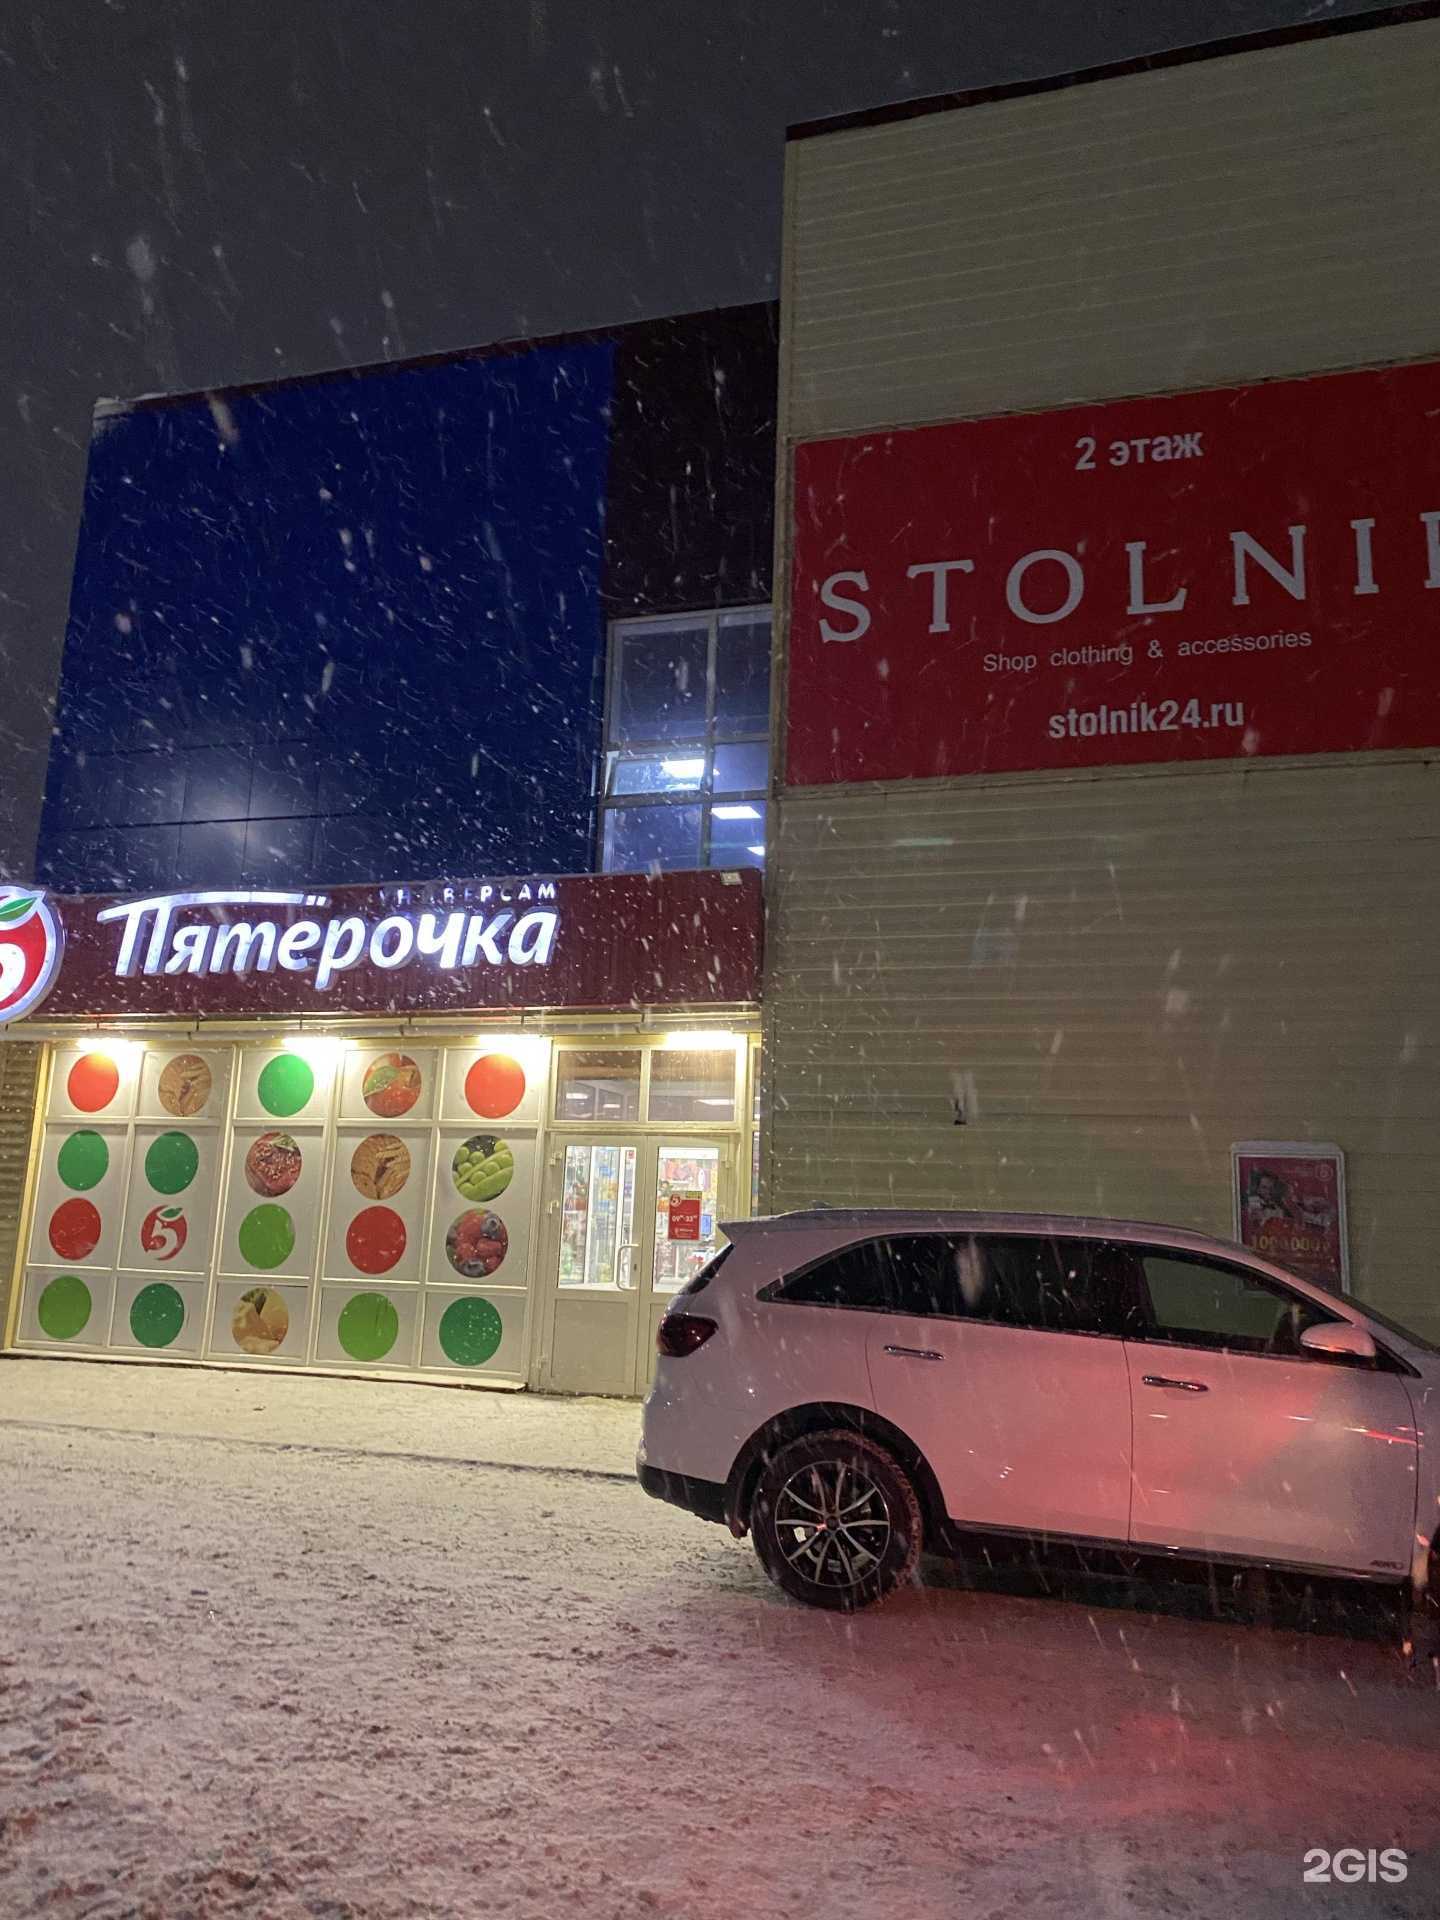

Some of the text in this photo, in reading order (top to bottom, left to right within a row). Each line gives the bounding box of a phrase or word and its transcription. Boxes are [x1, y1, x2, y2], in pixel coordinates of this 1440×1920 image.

[1075, 432, 1204, 470] 2 этаж
[983, 630, 1312, 673] Shop clothing & accessories
[1049, 699, 1244, 739] stolnik24.ru
